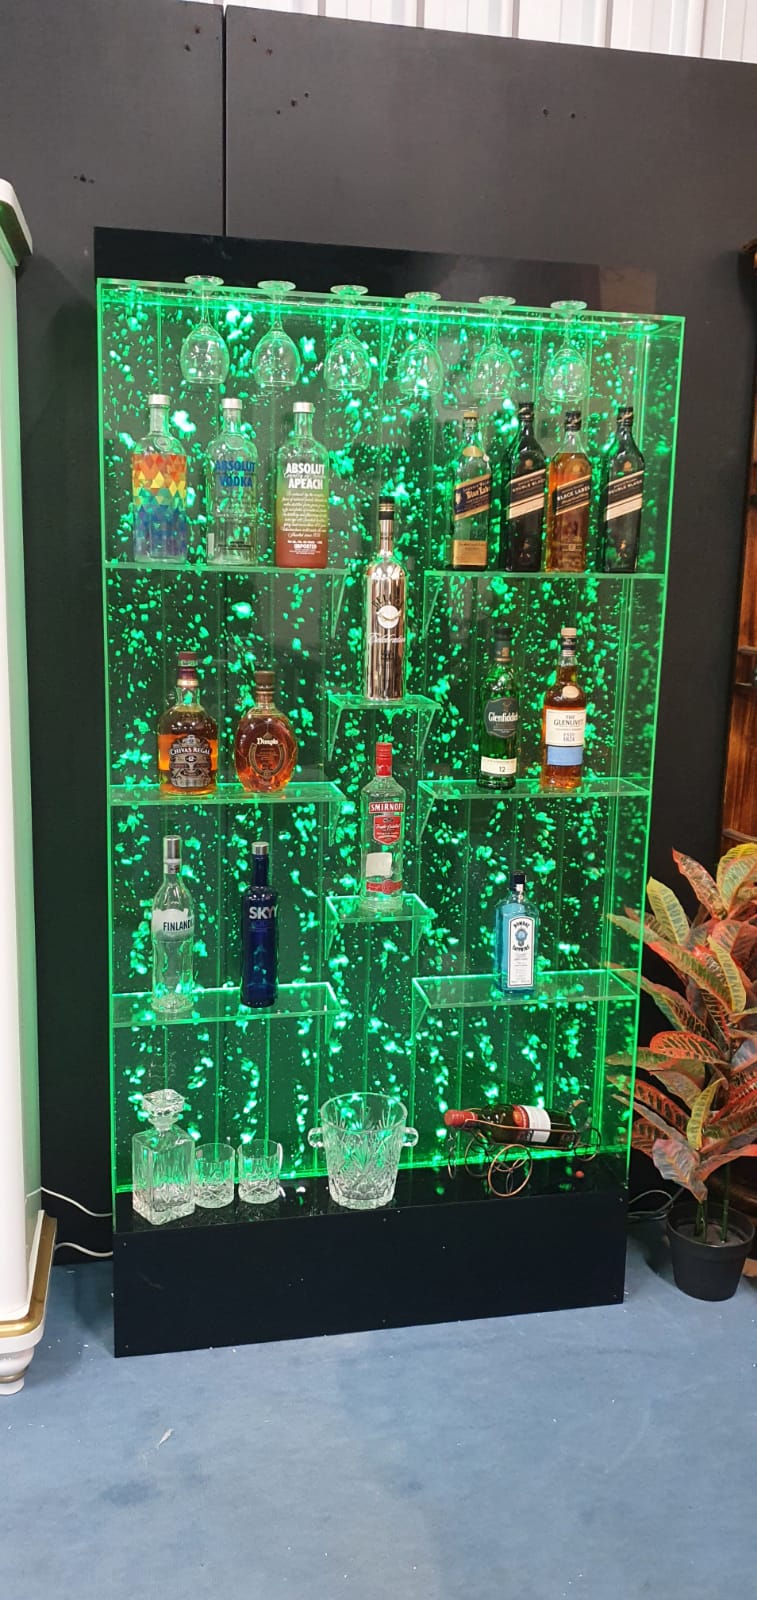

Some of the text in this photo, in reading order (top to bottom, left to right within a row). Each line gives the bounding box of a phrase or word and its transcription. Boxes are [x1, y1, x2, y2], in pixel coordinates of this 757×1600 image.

[216, 460, 255, 472] ABSOLUT
[286, 462, 325, 475] ABSOLUT
[219, 476, 253, 487] VODKA
[288, 478, 324, 490] APEACH
[557, 490, 575, 501] BLACK
[256, 737, 279, 746] Dimple
[249, 905, 278, 920] SKYY
